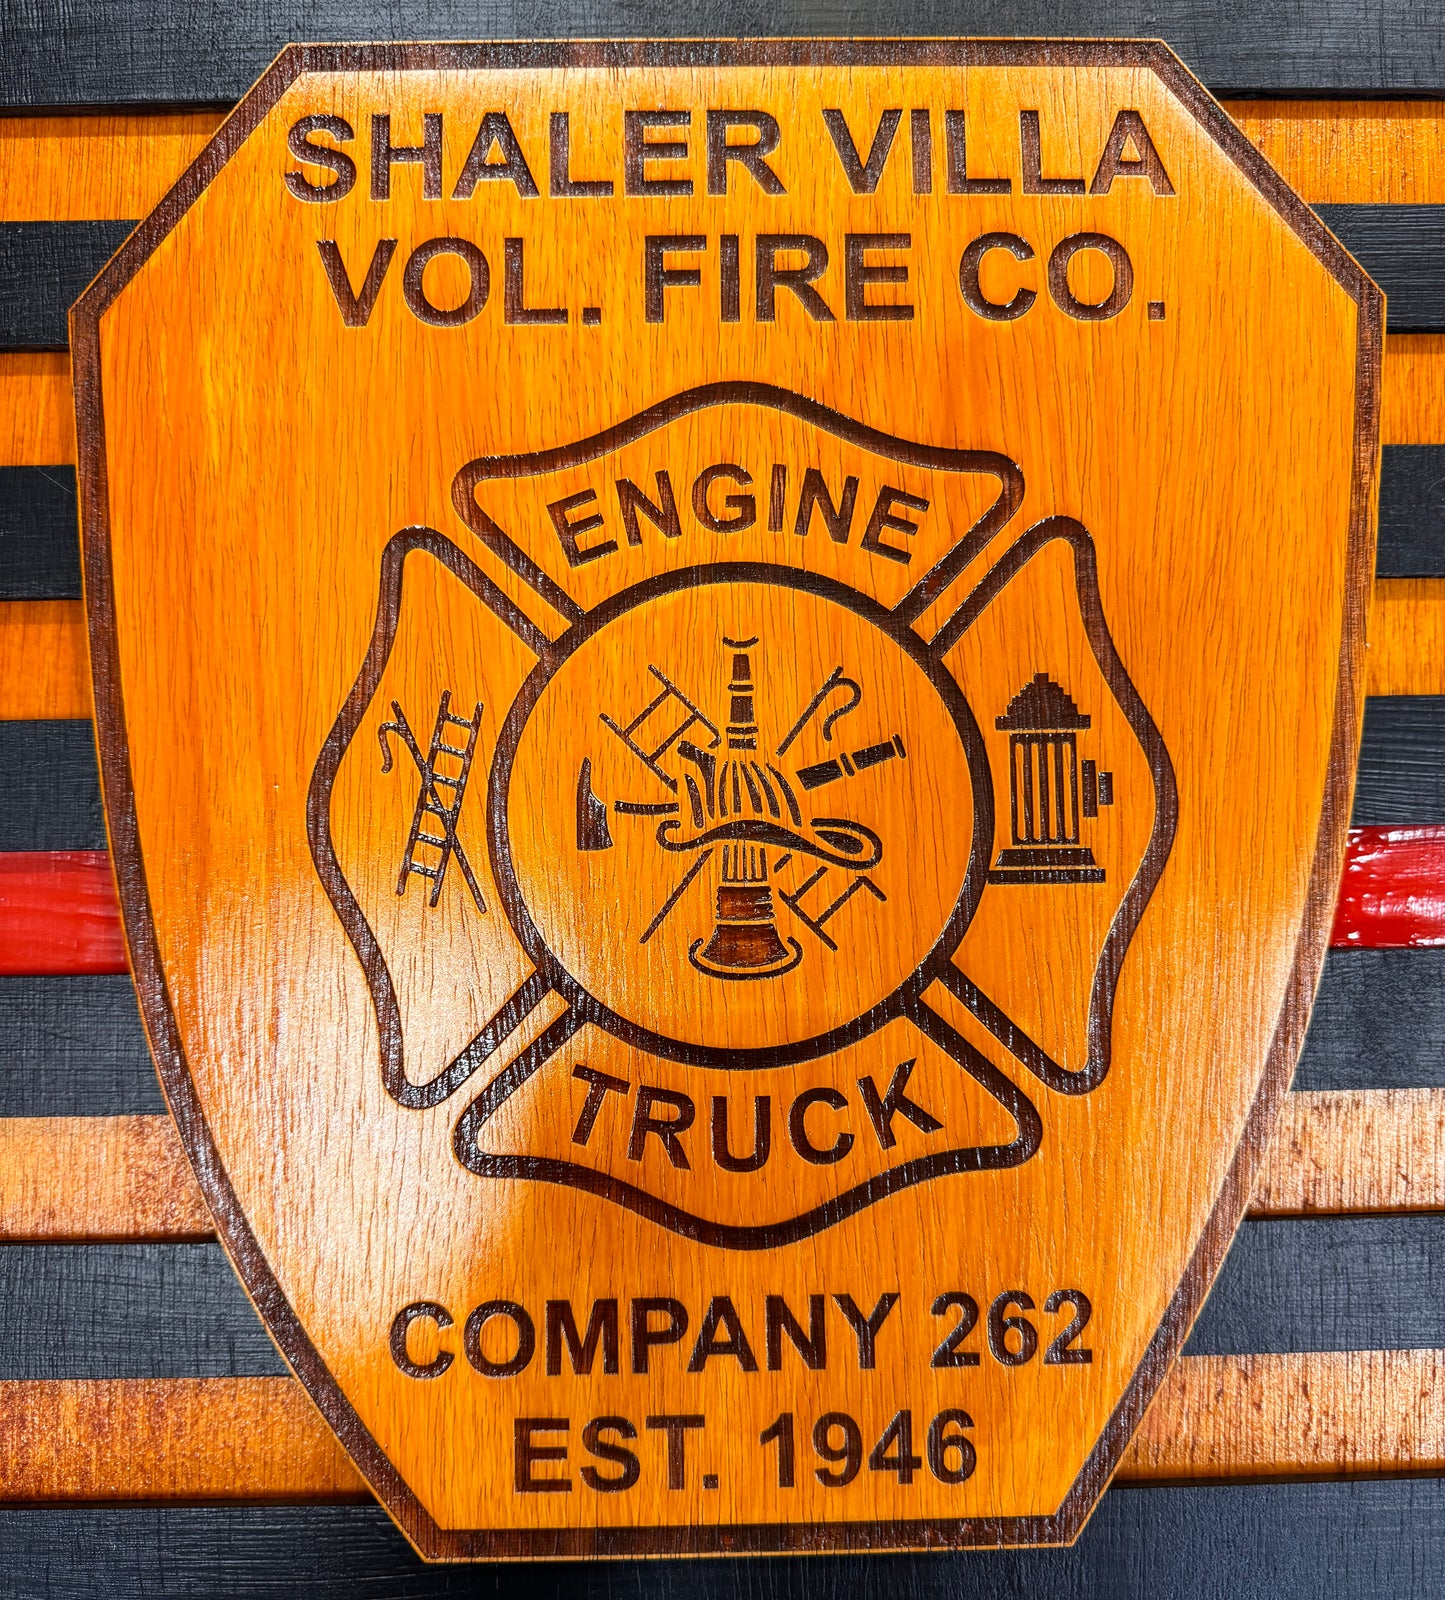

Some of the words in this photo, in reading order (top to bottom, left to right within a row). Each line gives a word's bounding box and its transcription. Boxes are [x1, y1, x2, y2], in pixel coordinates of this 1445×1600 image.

[284, 107, 788, 202] SHALER
[823, 107, 1177, 198] VILLA
[316, 237, 603, 329] VOL.
[645, 233, 916, 323] FIRE
[959, 232, 1166, 321] CO.
[547, 463, 930, 568] ENGINE
[569, 1058, 945, 1173] TRUCK
[391, 1293, 902, 1378] COMPANY
[931, 1288, 1093, 1366] 262
[514, 1414, 719, 1493] EST.
[760, 1409, 979, 1488] 1946
